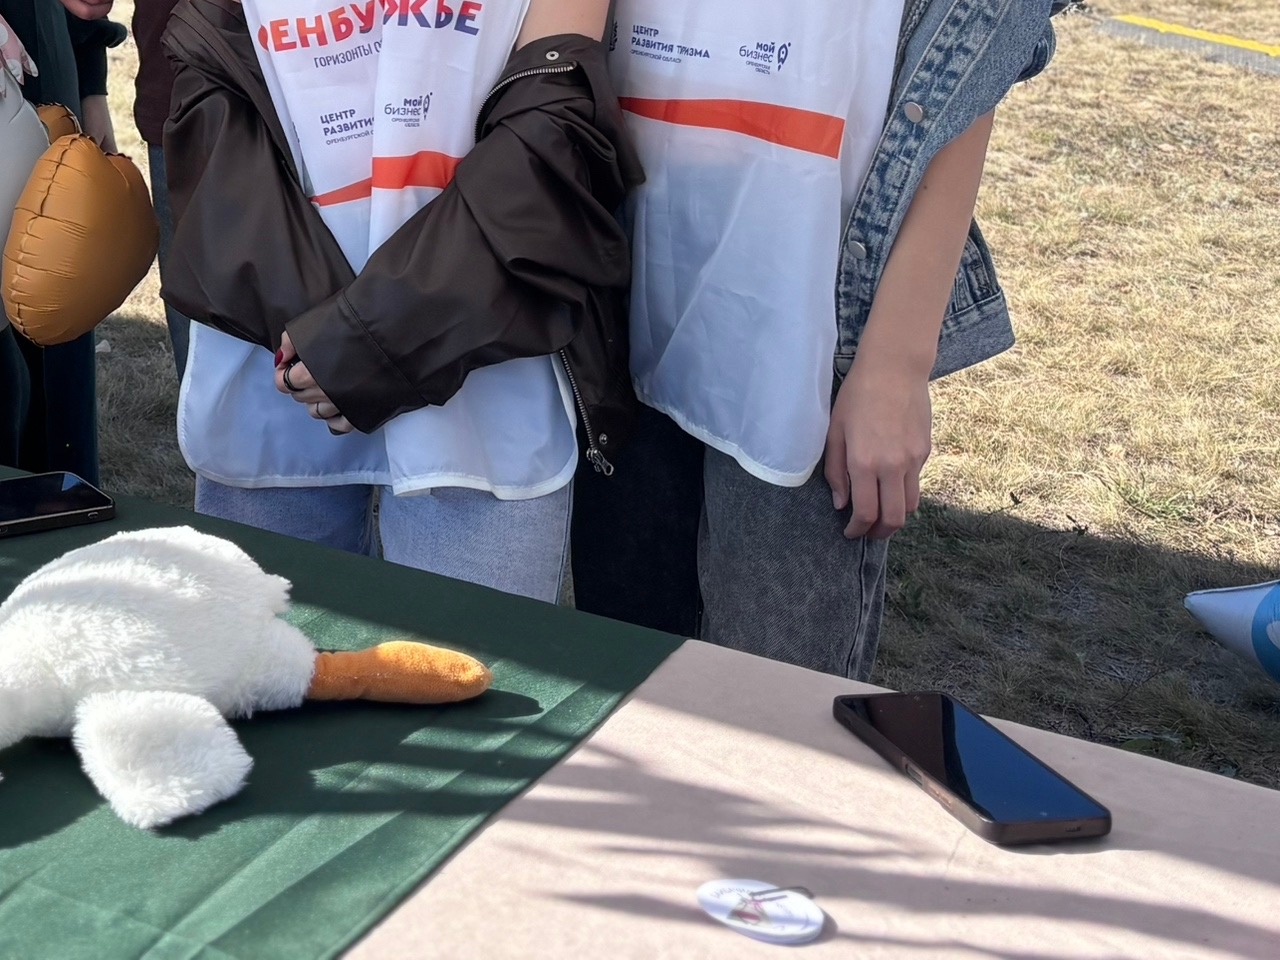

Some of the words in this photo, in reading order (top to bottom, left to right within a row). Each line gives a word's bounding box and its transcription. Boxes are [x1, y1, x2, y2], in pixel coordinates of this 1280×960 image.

[633, 24, 659, 38] ЦЕНТР
[631, 36, 674, 53] РАЗВИТИЯ
[313, 43, 372, 68] ГОРИЗОНТЫ
[739, 45, 773, 63] бизнес
[320, 108, 356, 125] ЦЕНТР
